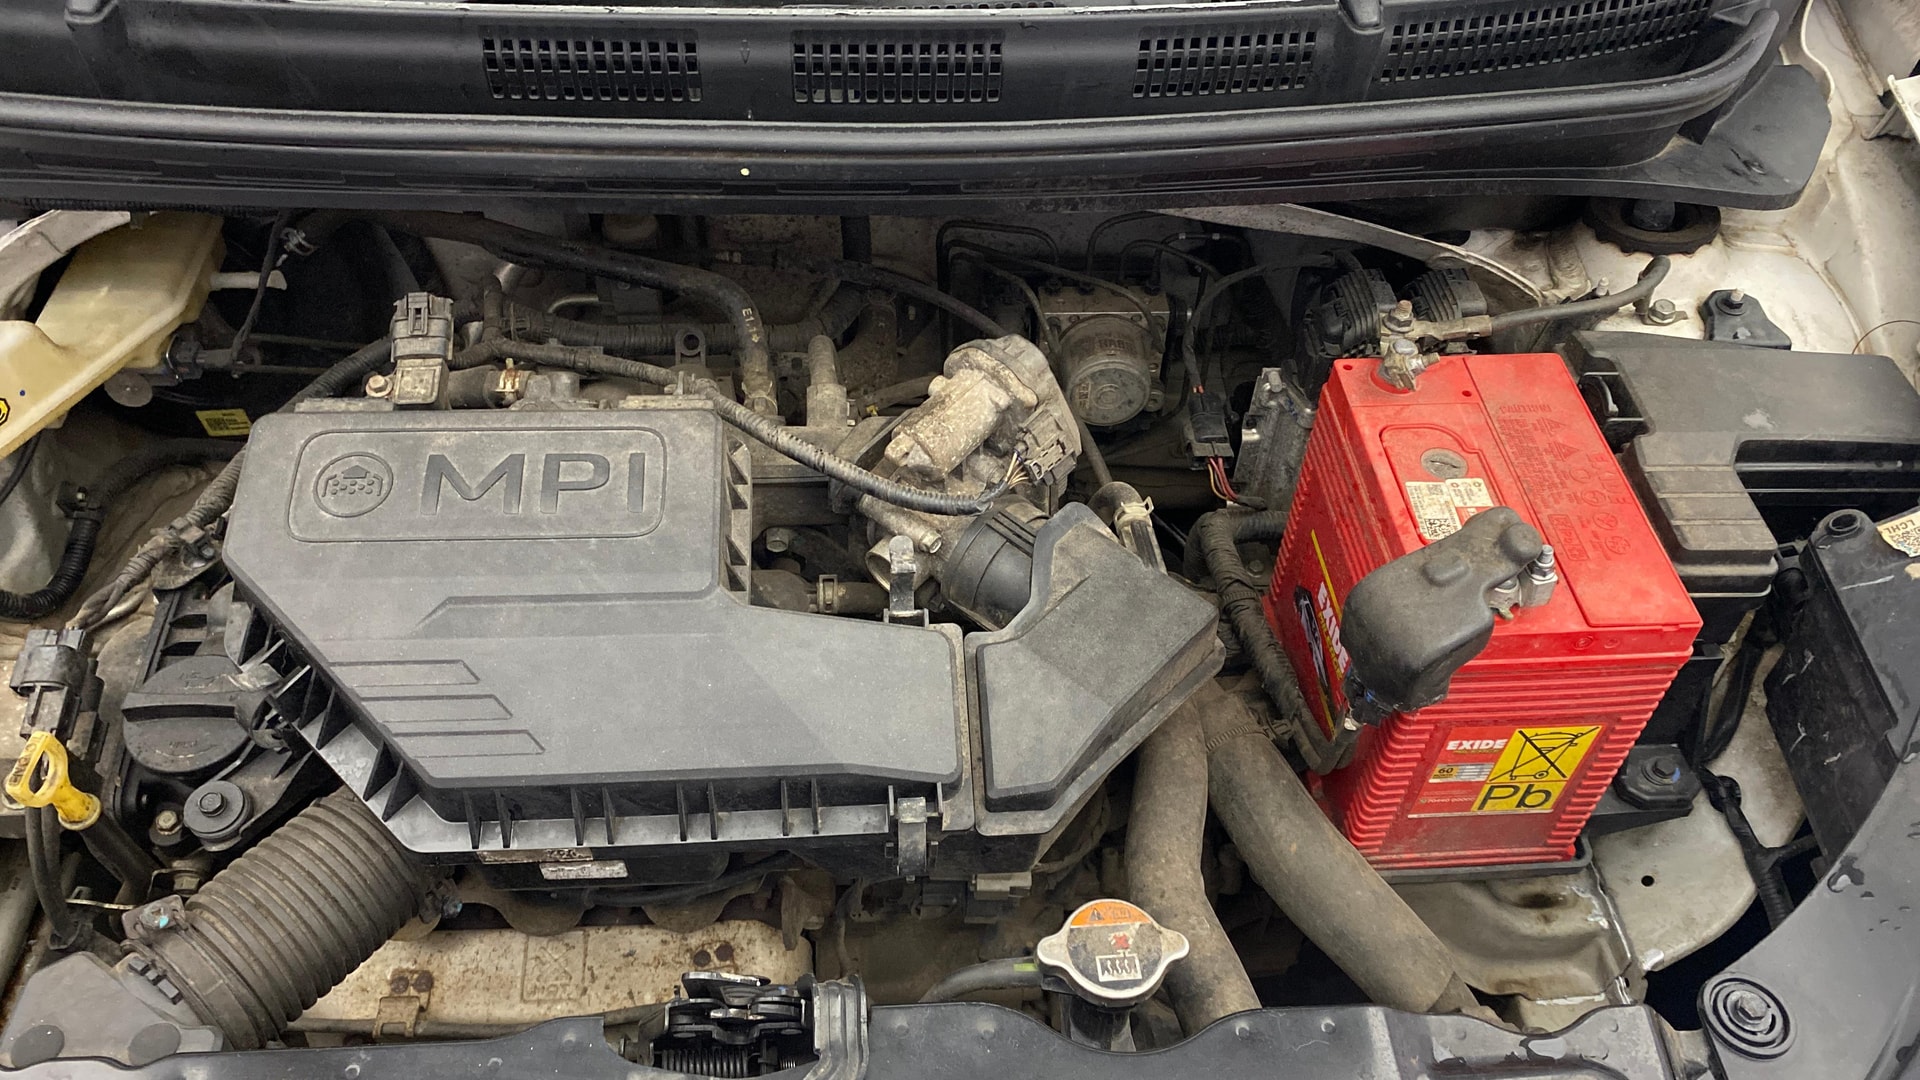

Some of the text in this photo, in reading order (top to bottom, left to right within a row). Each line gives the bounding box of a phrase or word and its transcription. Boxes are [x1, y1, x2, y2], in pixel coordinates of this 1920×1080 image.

[420, 452, 646, 515] MPI
[1317, 582, 1349, 674] EXIDE
[1446, 739, 1508, 750] EXIDE
[1438, 767, 1454, 775] 60
[1477, 784, 1553, 811] Pb
